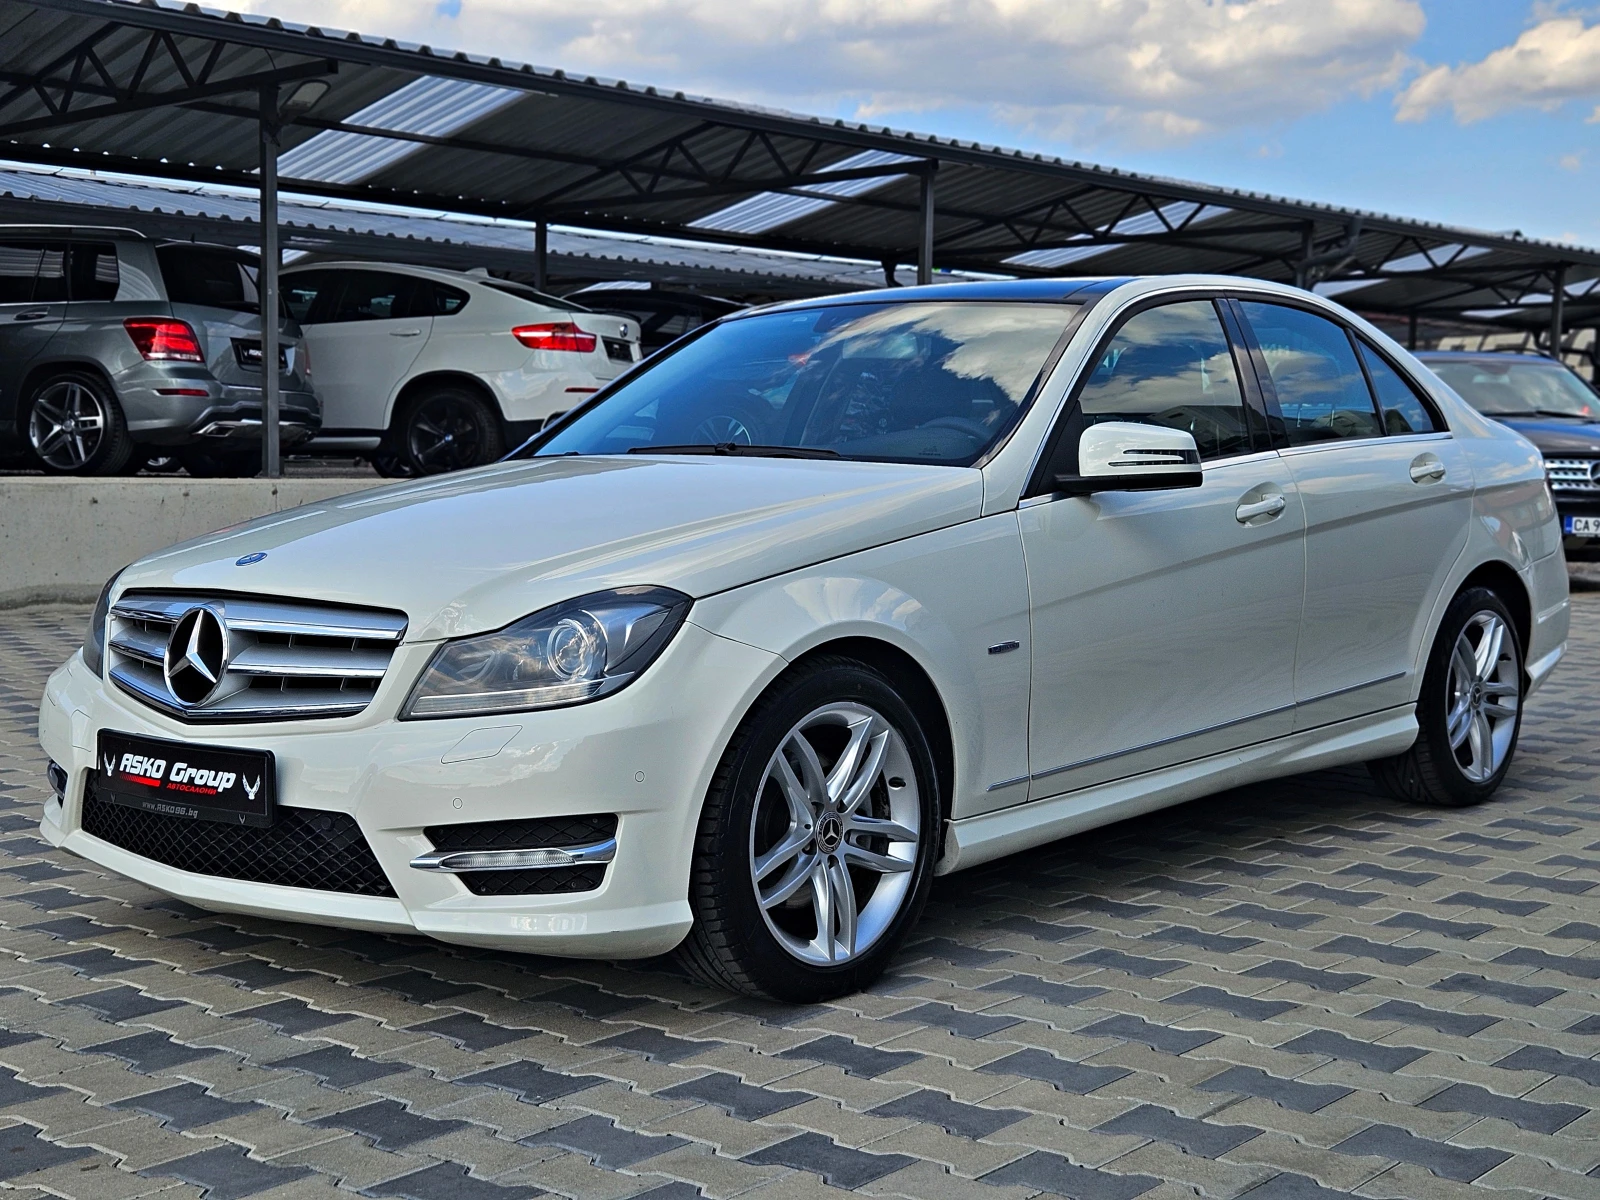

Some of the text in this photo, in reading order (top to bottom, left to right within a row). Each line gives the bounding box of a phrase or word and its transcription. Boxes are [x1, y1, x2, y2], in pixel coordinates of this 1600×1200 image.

[1574, 519, 1590, 531] CA
[119, 753, 236, 792] ASKO Group
[166, 782, 217, 795] АВТОСАЛОНИ
